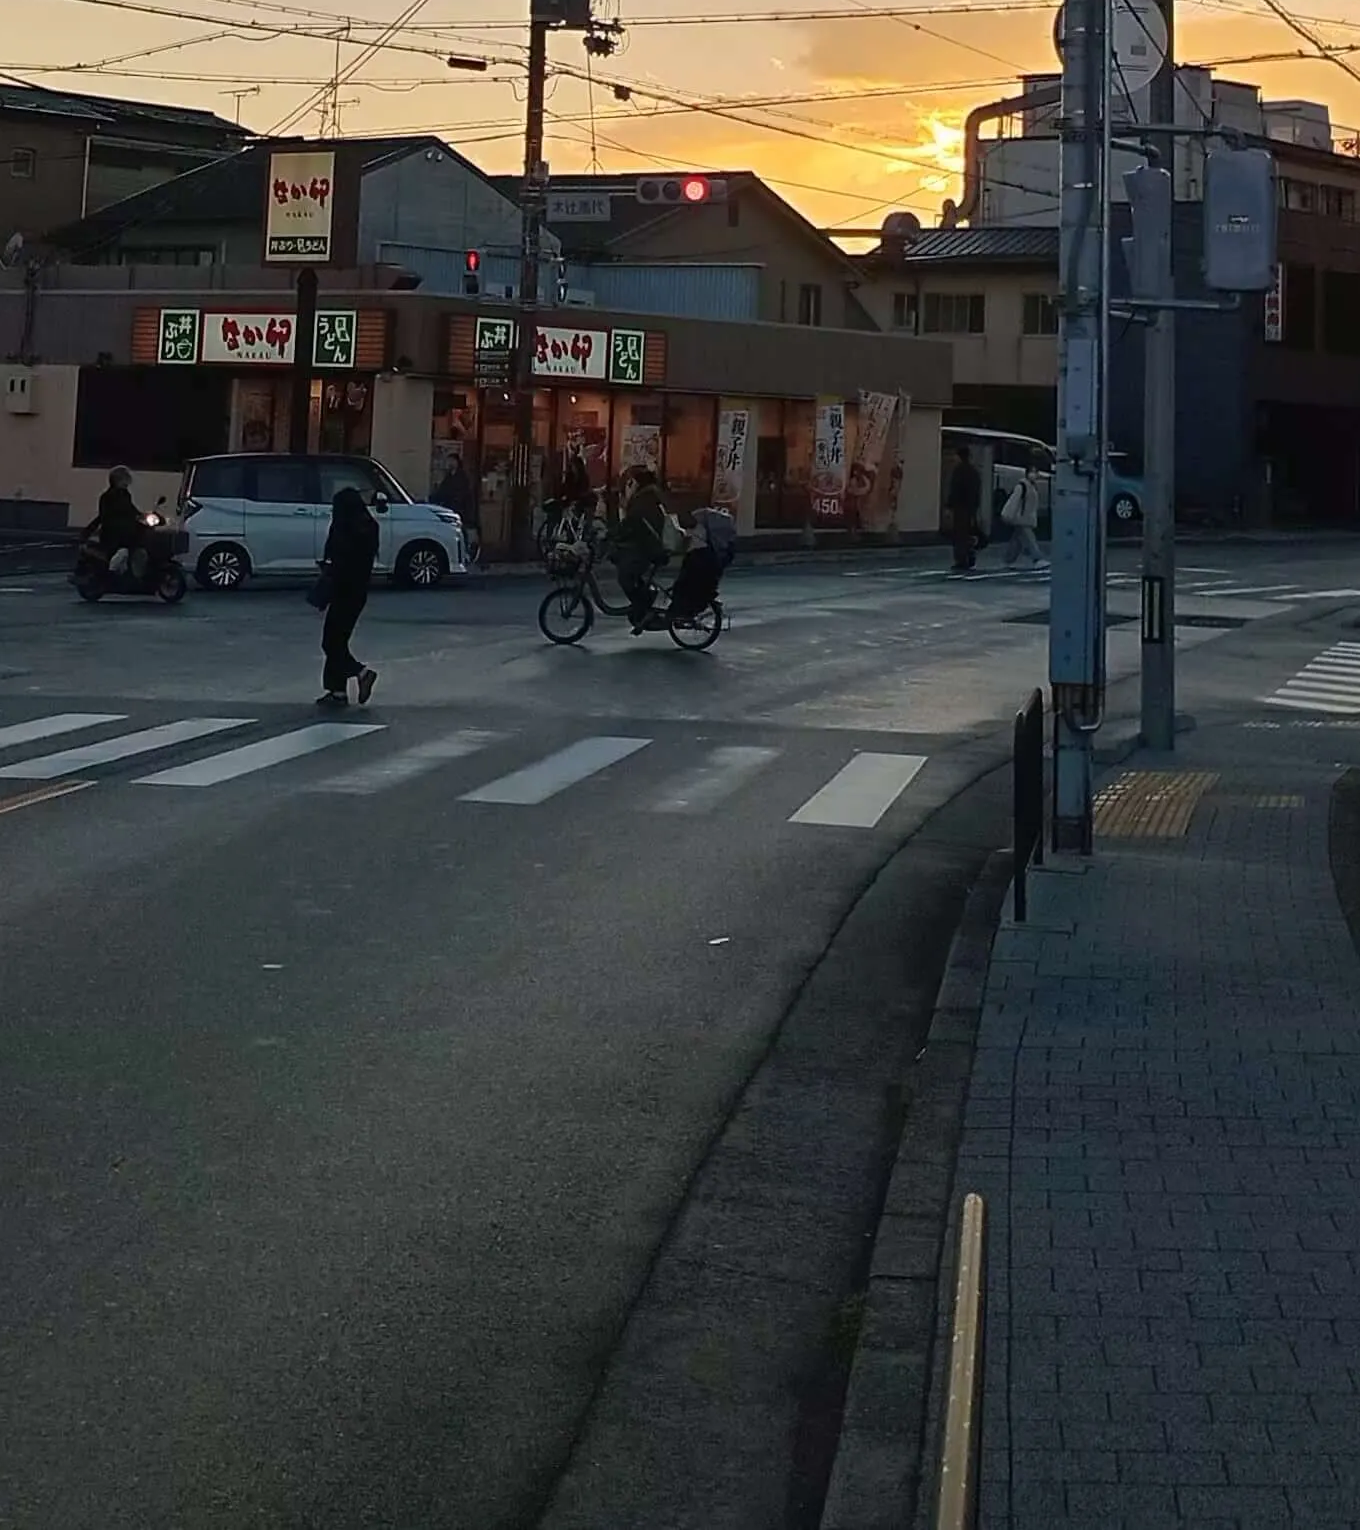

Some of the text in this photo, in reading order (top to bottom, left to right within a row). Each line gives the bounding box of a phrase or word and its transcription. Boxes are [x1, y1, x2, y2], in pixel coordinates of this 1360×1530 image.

[273, 178, 330, 209] なか卯
[222, 317, 292, 358] なか卯
